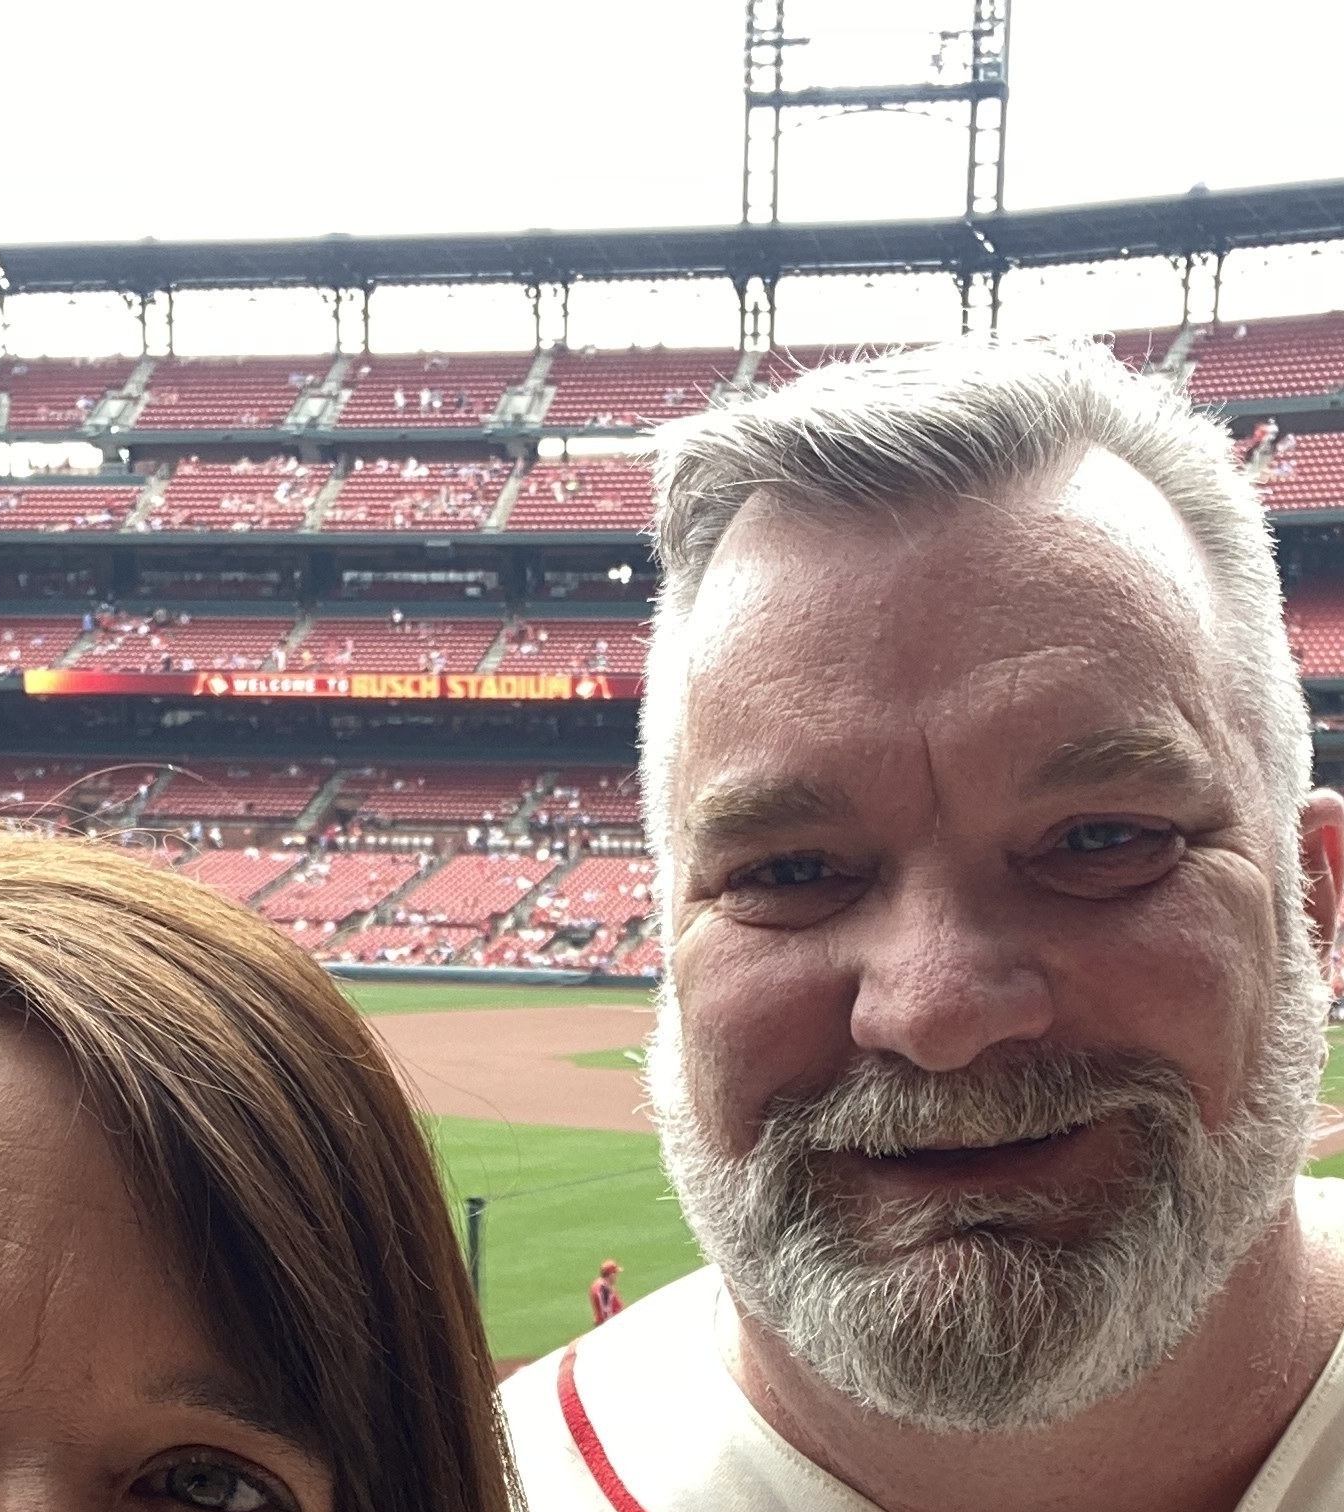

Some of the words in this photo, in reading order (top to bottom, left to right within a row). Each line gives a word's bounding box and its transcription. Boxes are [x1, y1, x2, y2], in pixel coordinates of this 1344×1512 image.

[233, 678, 316, 693] WELCOME
[326, 678, 349, 693] TO
[351, 675, 440, 698] BUSCH
[446, 674, 572, 699] STADIUM
